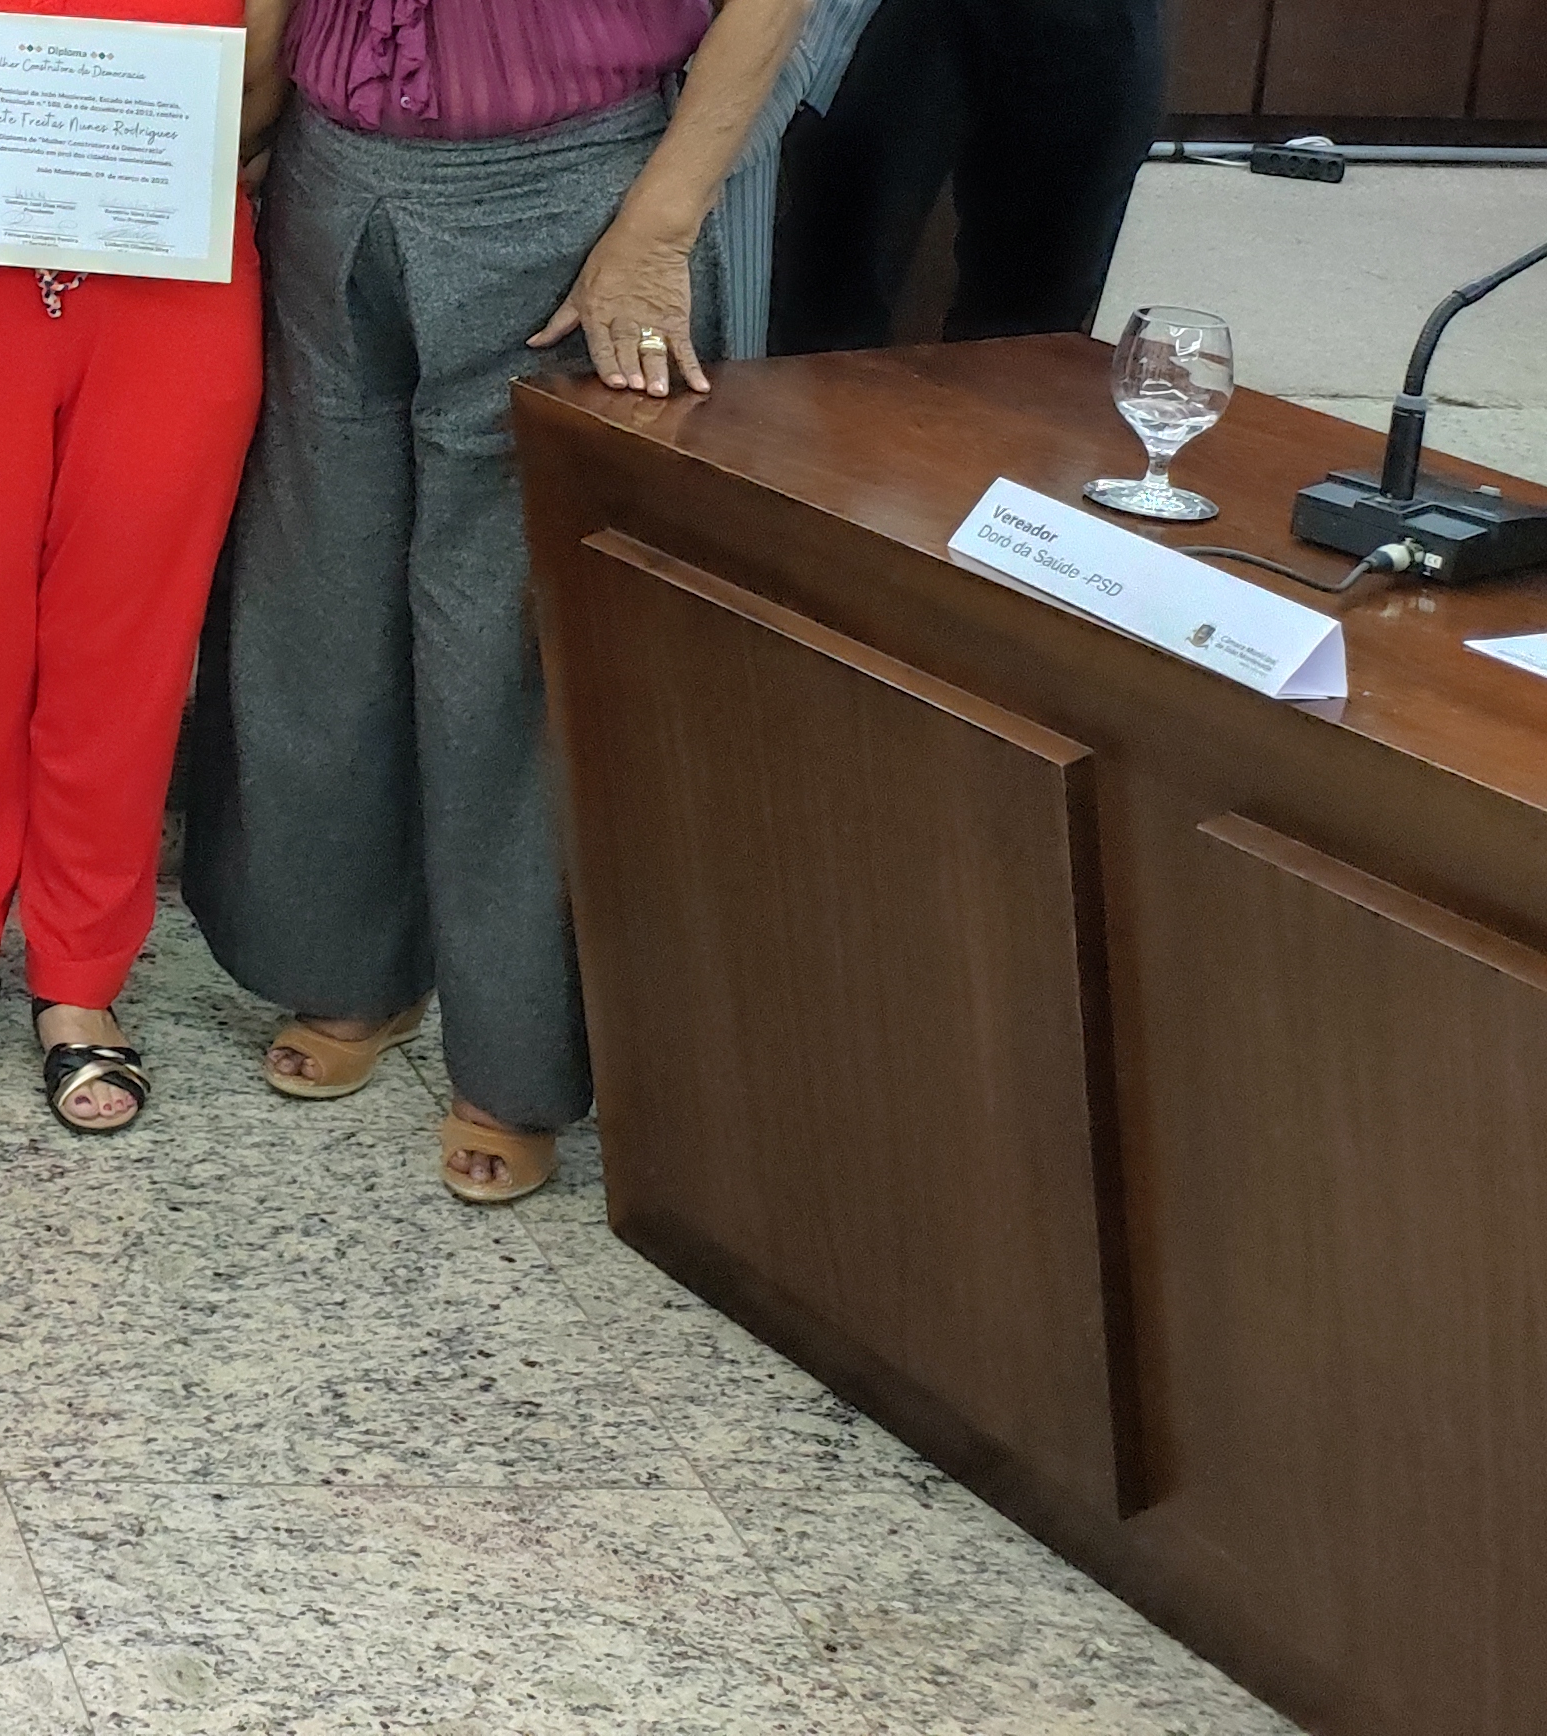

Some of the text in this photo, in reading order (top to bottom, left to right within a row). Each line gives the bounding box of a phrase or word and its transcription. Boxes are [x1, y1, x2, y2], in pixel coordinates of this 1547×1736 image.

[22, 58, 75, 74] Construtora
[76, 63, 90, 75] da
[91, 64, 146, 80] Democracia
[47, 45, 87, 59] Diploma
[20, 109, 64, 130] Freitas
[68, 115, 108, 133] Nunes
[112, 120, 178, 146] Rodrigues
[993, 504, 1059, 543] Vereador
[977, 524, 1012, 548] Doró
[1012, 541, 1033, 558] da
[1033, 549, 1081, 579] Saúde
